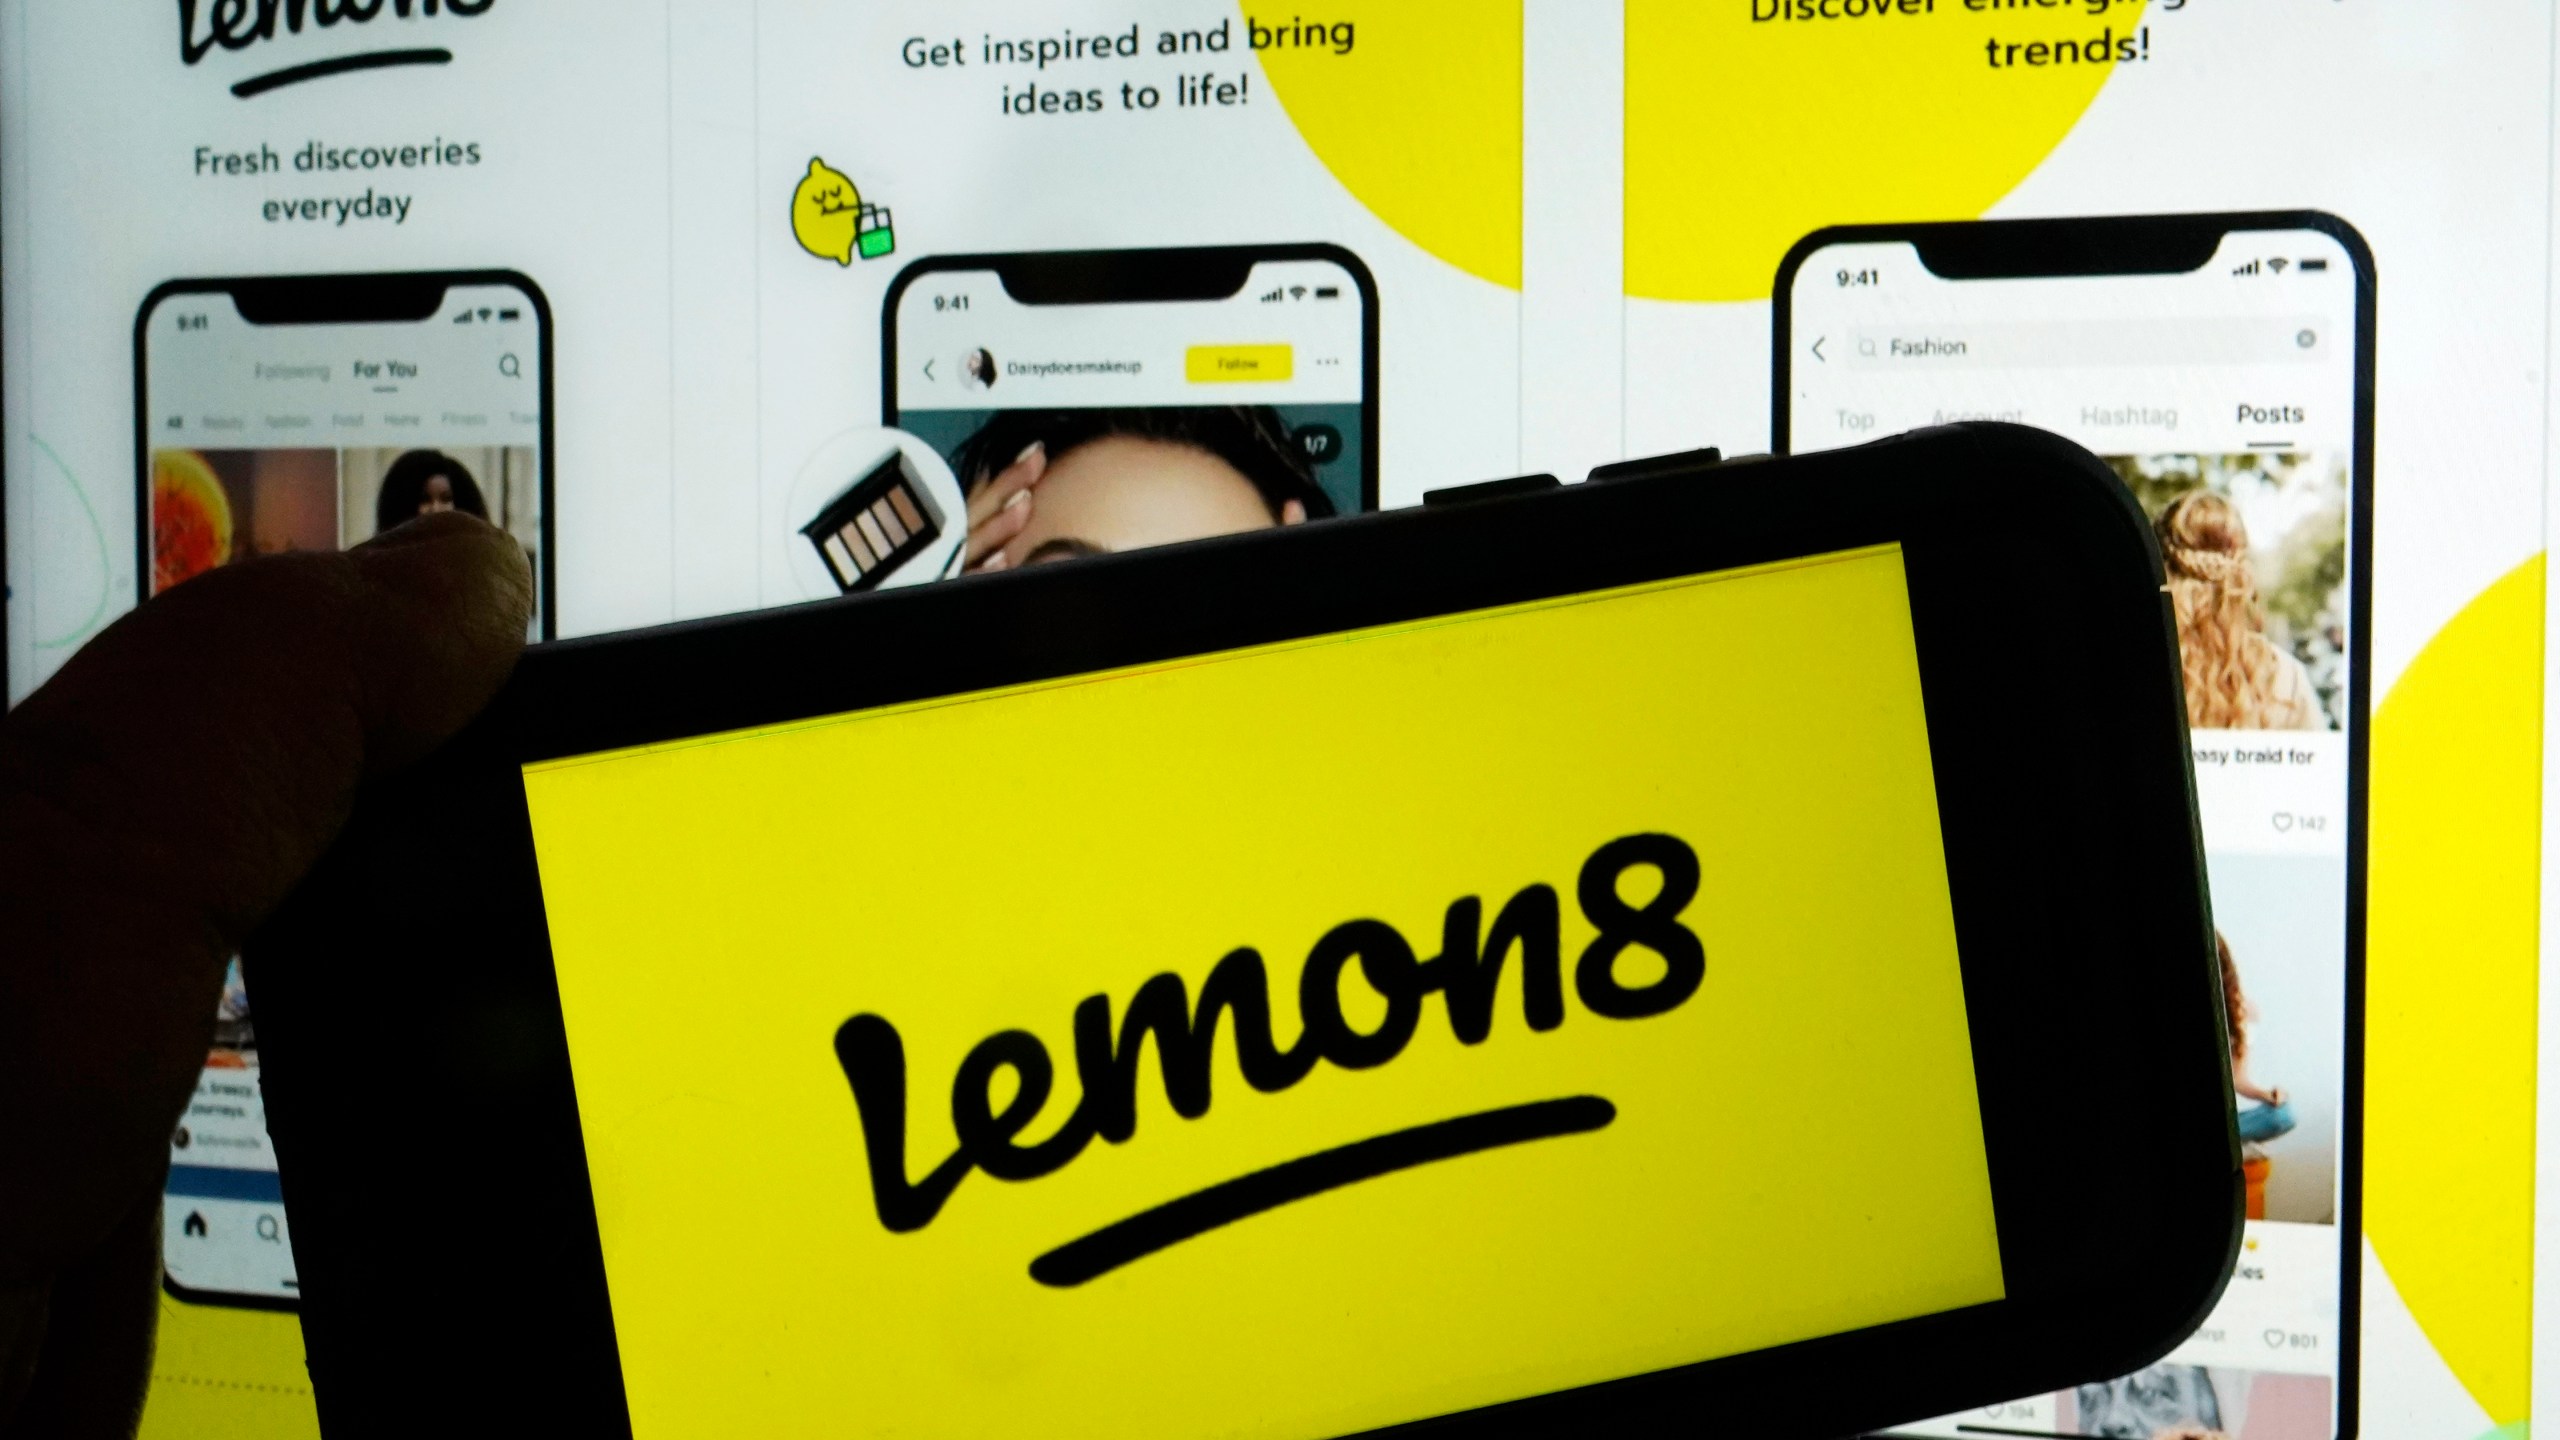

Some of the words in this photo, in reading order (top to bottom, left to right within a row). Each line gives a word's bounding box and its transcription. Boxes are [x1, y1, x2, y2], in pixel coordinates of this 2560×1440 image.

[1751, 0, 1934, 23] Discover
[177, 0, 494, 66] Lem
[902, 37, 965, 69] Get
[983, 24, 1139, 69] inspired
[1156, 18, 1230, 56] and
[1248, 15, 1355, 56] bring
[1985, 26, 2149, 69] trends!
[1002, 82, 1104, 115] ideas
[1120, 82, 1160, 111] to
[1178, 72, 1248, 108] life!
[194, 143, 280, 176] Fresh
[293, 136, 481, 173] discoveries
[262, 187, 412, 227] everyday
[1836, 269, 1879, 288] 9:41
[933, 295, 970, 312] 9:41
[176, 314, 209, 332] 9:41
[1890, 338, 1967, 357] Fashion
[353, 360, 381, 379] For
[386, 360, 418, 379] You
[1006, 360, 1142, 378] Daisydoesmakeup
[1836, 408, 1876, 433] Top
[2080, 404, 2179, 430] Hashtag
[2236, 403, 2305, 424] Posts
[1303, 434, 1329, 456] 1/7
[2234, 747, 2283, 764] braid
[2287, 746, 2315, 765] for
[833, 832, 1706, 1234] Lemon8
